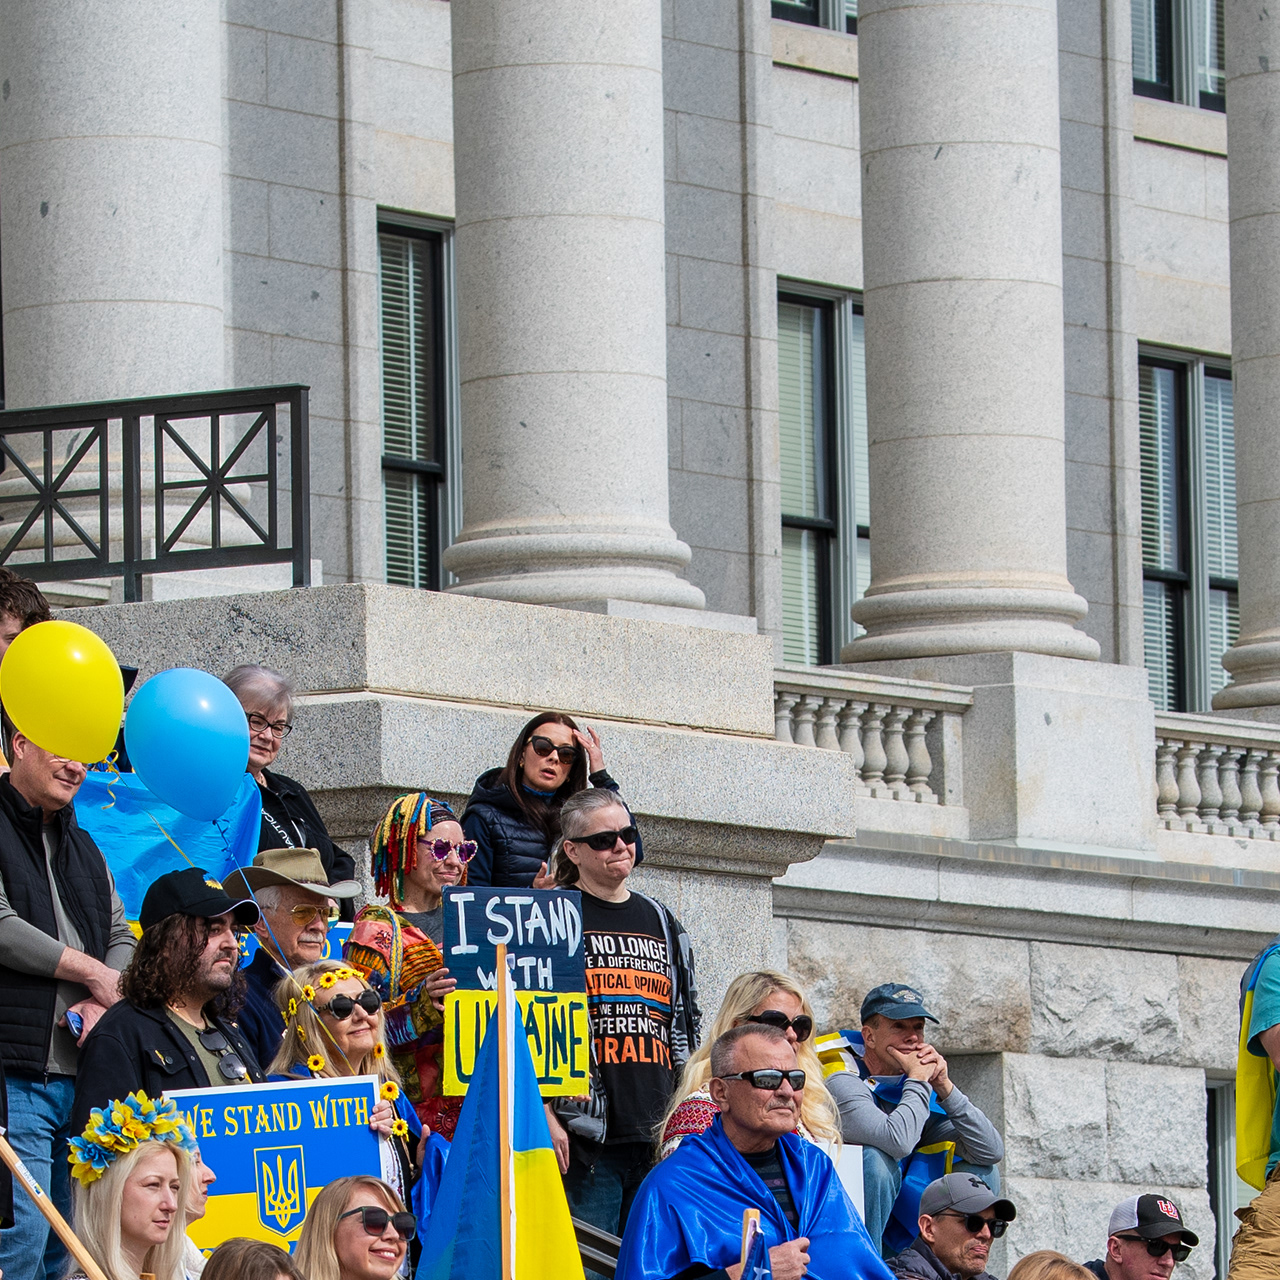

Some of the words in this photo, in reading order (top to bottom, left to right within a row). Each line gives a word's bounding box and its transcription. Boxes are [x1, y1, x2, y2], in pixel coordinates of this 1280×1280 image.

[449, 892, 479, 956] I
[485, 895, 584, 957] STAND
[590, 935, 617, 955] NO
[618, 936, 671, 965] LONGE
[597, 956, 606, 968] A
[608, 956, 666, 974] DIFFERENCE
[585, 973, 632, 991] LITICAL
[599, 1003, 613, 1016] WE
[616, 1003, 643, 1016] HAVE
[223, 1101, 302, 1137] STAND
[308, 1093, 370, 1129] WITH
